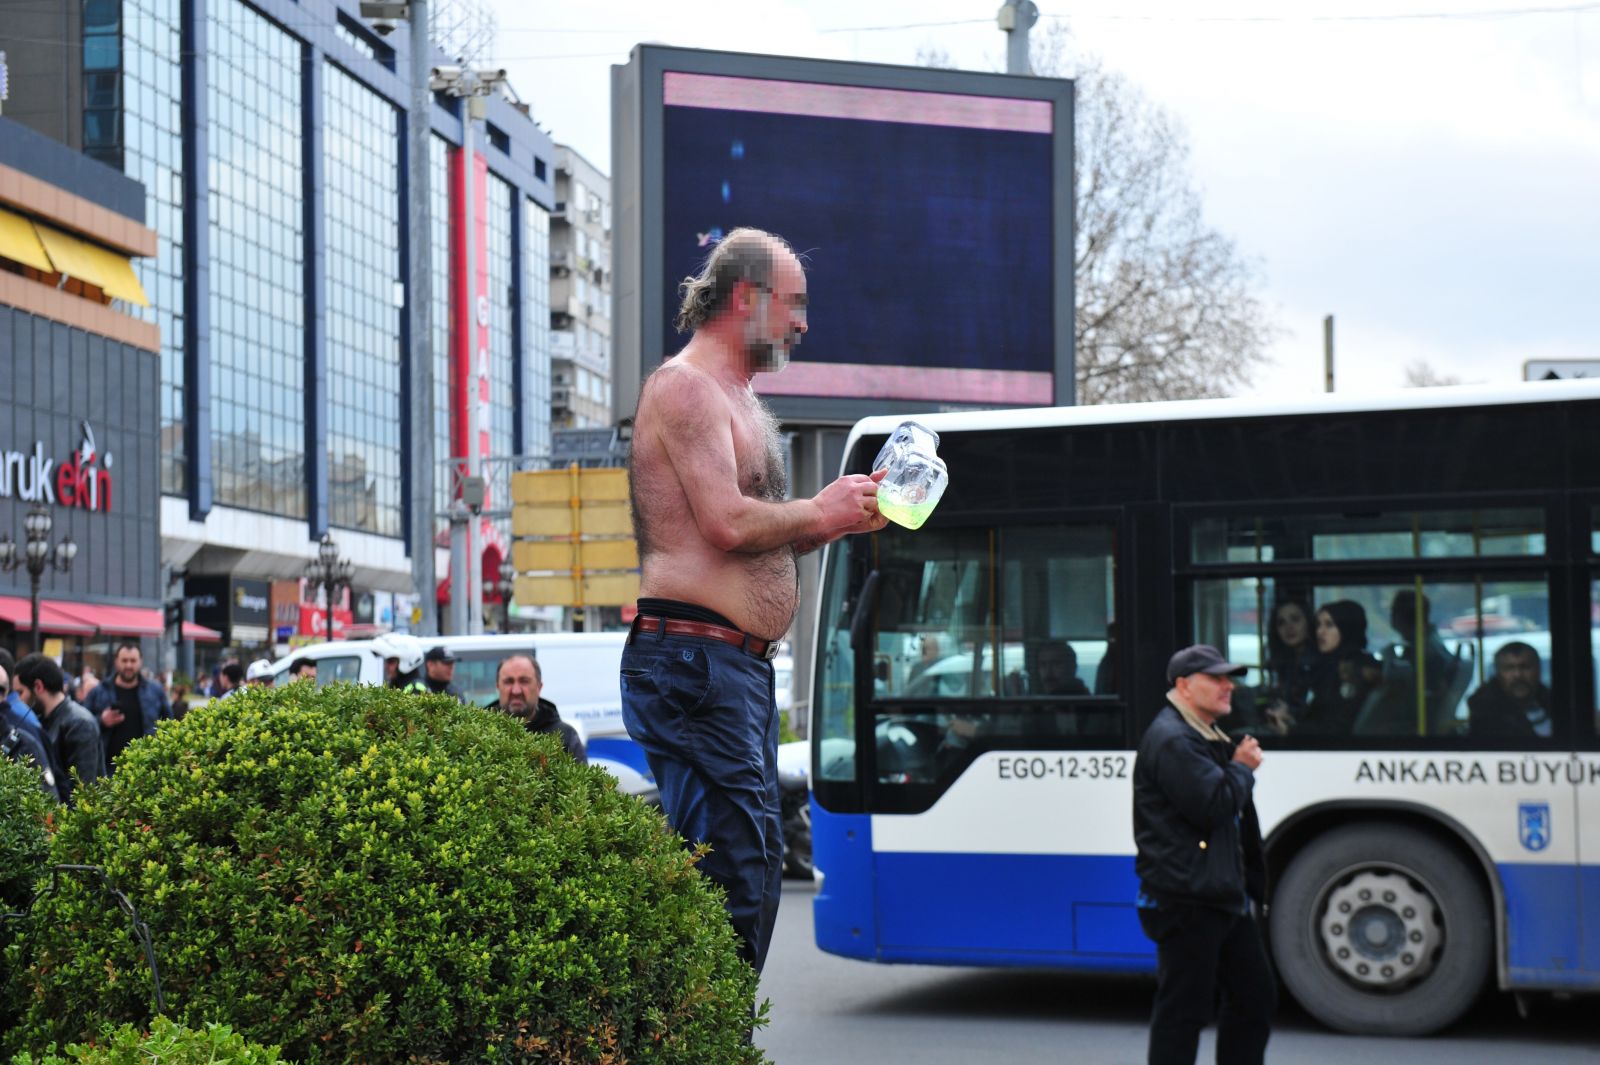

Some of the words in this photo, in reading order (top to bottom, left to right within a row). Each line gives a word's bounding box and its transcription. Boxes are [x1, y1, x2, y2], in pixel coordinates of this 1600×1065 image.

[57, 449, 112, 512] ekin
[998, 756, 1127, 779] EGO-12-352
[1355, 760, 1487, 784] ANKARA
